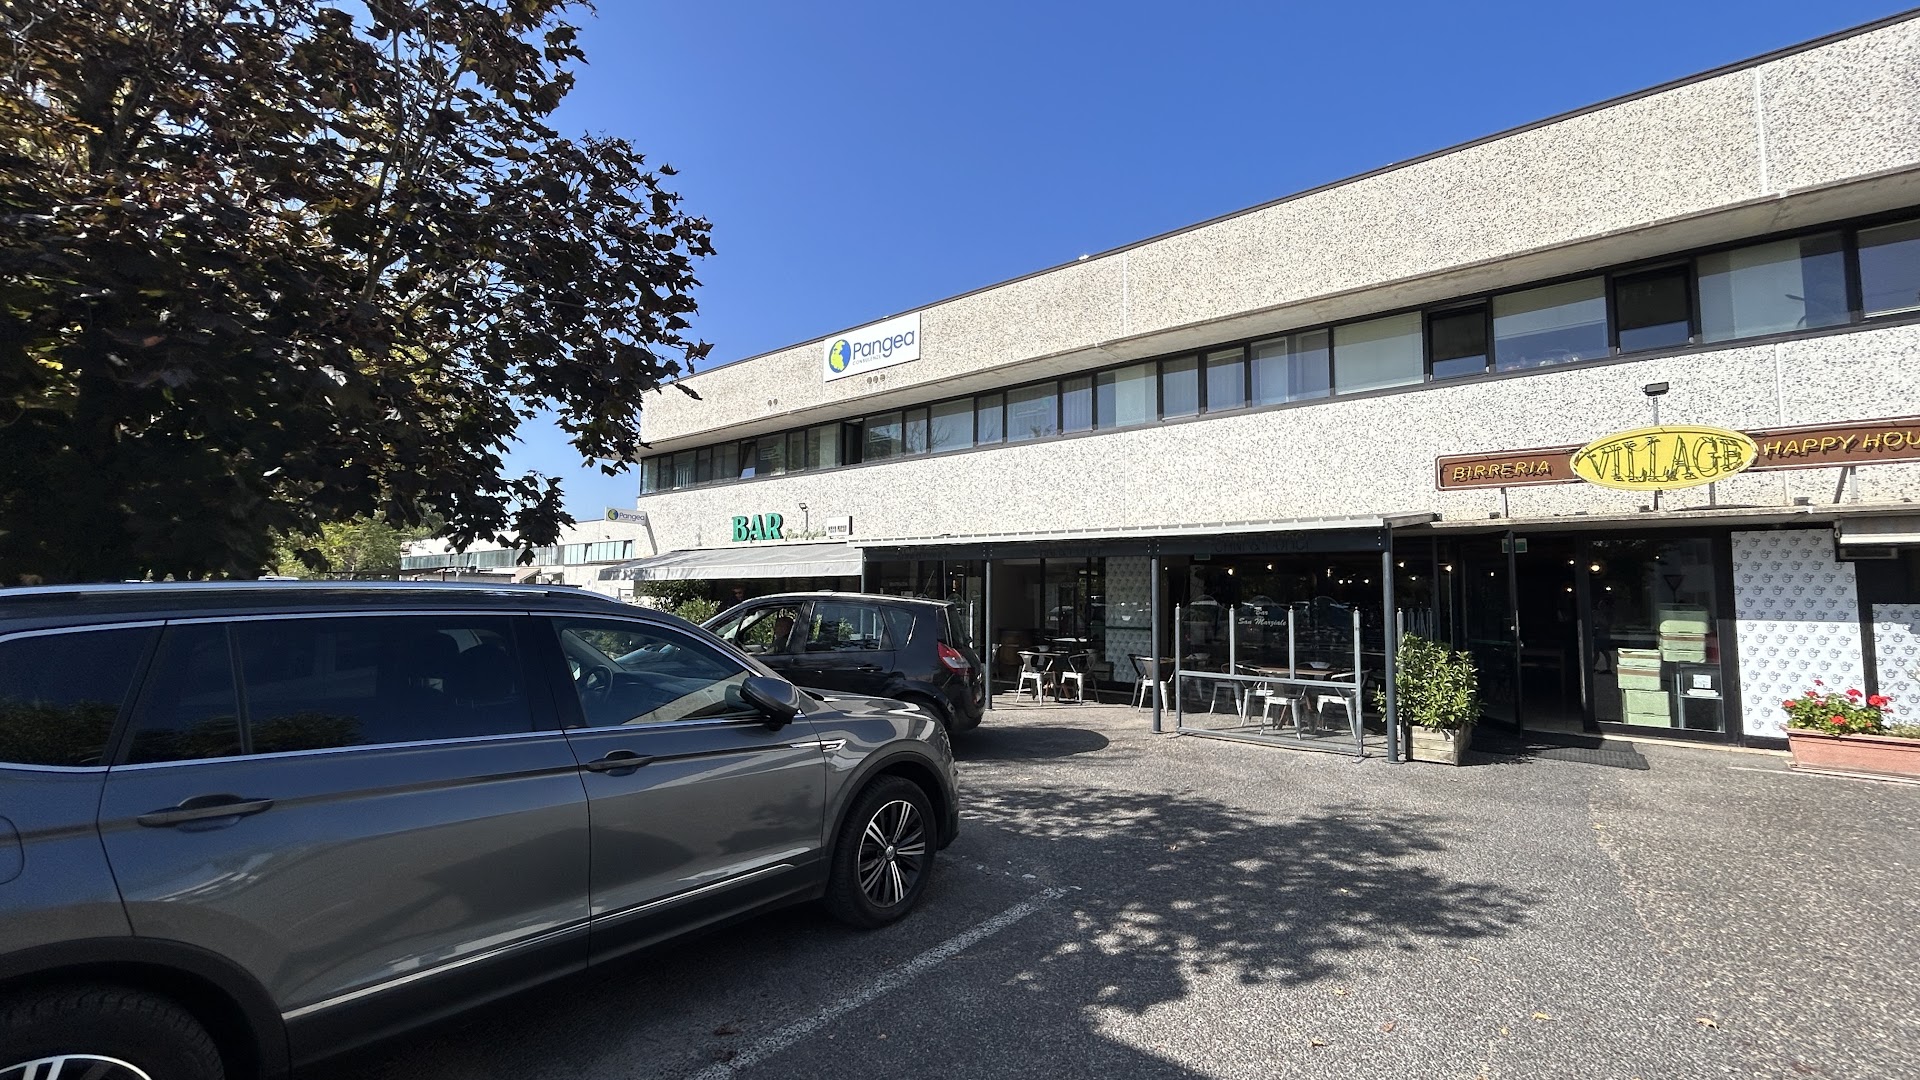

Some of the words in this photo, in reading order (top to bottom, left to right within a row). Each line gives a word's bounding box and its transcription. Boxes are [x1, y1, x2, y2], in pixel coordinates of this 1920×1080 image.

[853, 330, 915, 360] Pangea
[1764, 434, 1856, 456] HAPPY
[1587, 435, 1743, 482] VILLAGE
[1453, 460, 1550, 481] BIRRERIA
[619, 512, 645, 521] Pangea
[732, 512, 783, 542] BAR
[1238, 617, 1252, 625] San
[1254, 617, 1287, 627] Marziale
